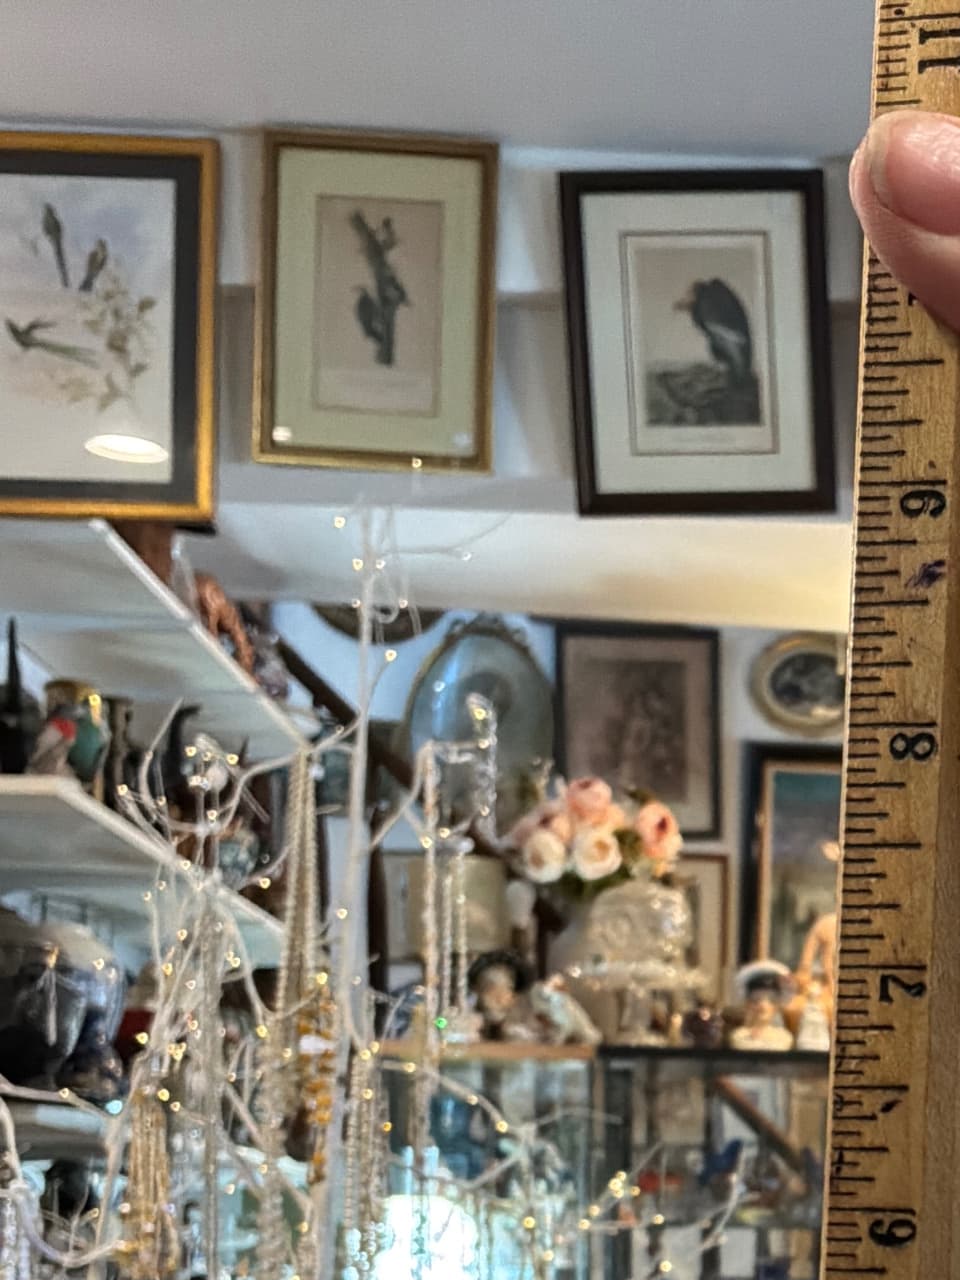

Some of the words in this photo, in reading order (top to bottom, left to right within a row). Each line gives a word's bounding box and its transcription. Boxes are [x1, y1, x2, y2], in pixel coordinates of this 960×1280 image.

[900, 489, 946, 517] 9
[890, 732, 937, 760] 8
[879, 974, 926, 1002] 7
[868, 1218, 917, 1247] 6
